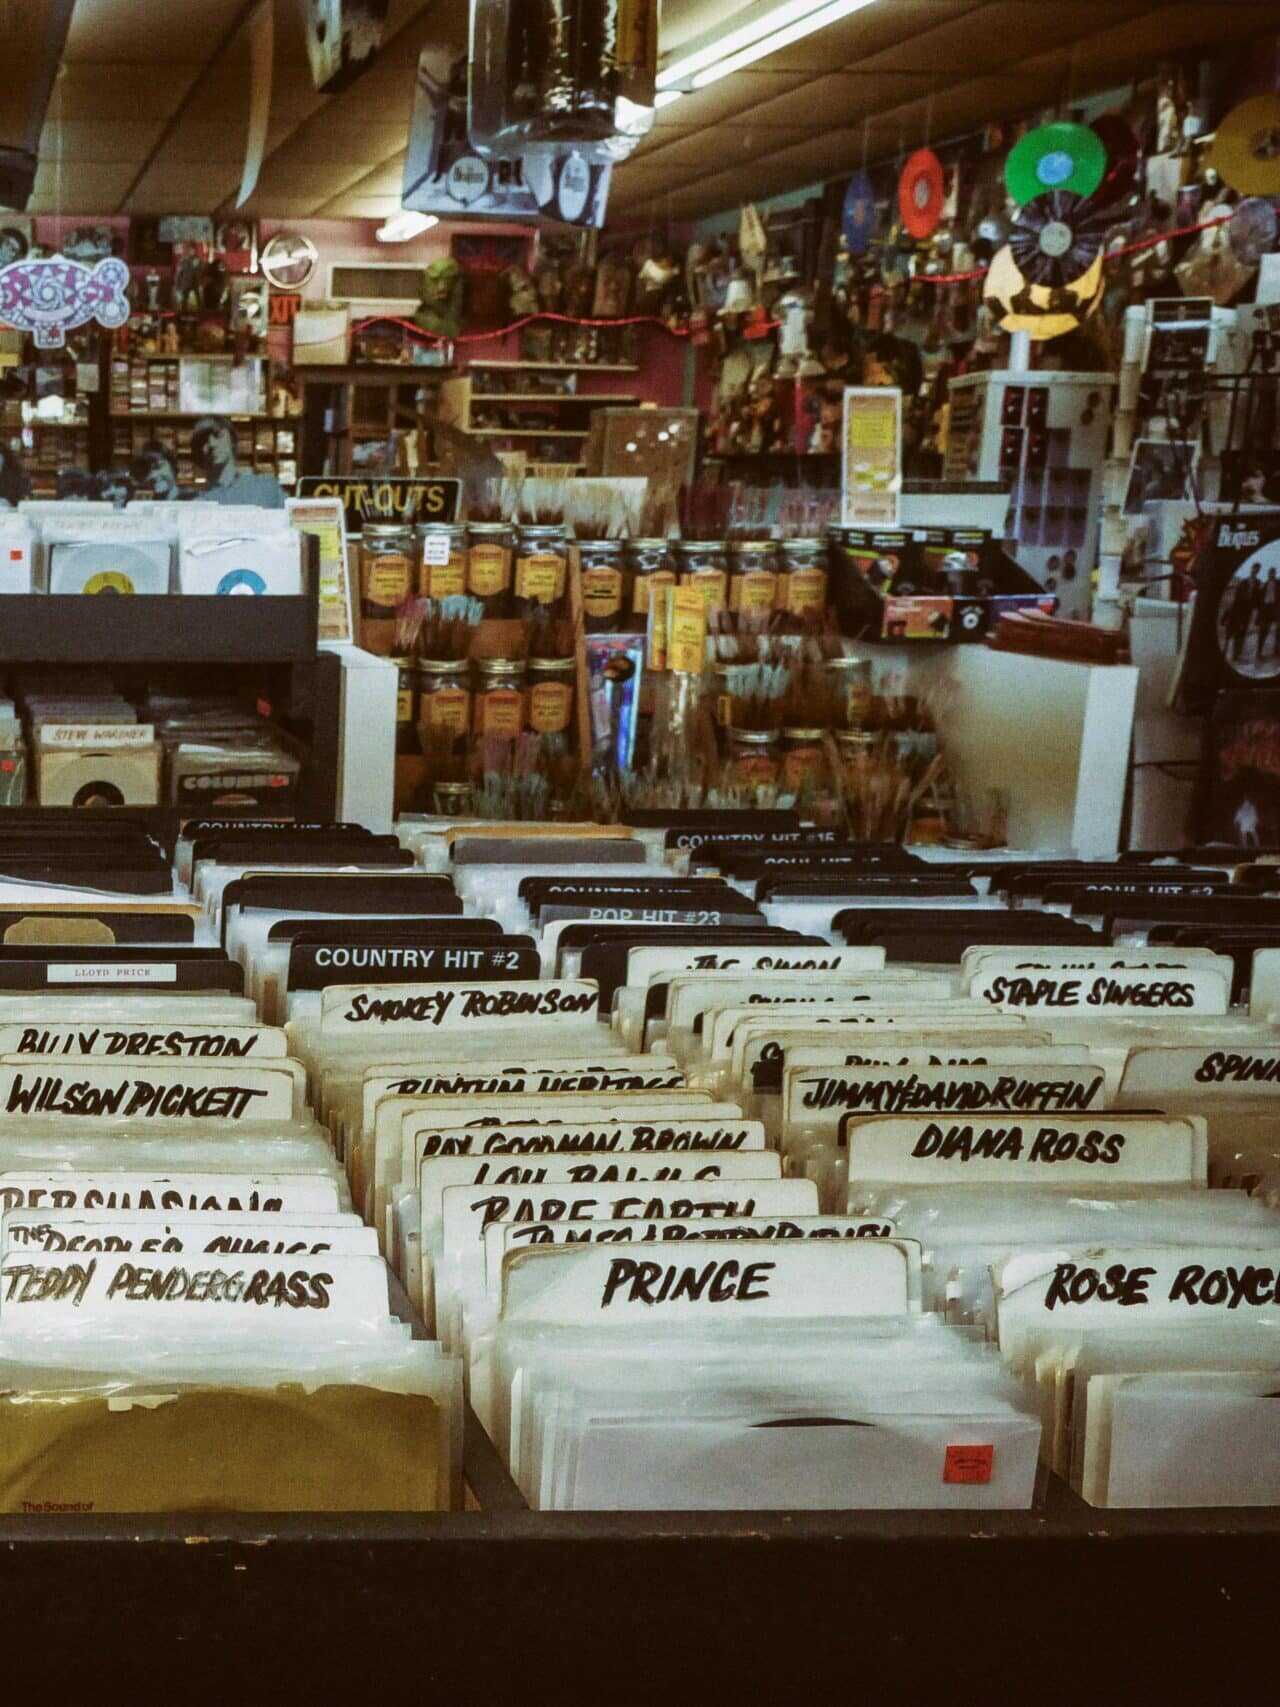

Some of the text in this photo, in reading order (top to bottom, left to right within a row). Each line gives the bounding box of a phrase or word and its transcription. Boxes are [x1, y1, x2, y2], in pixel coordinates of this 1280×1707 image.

[74, 967, 152, 977] LLOYD PRICE
[315, 948, 520, 970] COUNTRY HIT #2
[344, 988, 600, 1026] SMOKEY ROBINSON
[983, 976, 1196, 1008] STAPLE SINGERS
[5, 1073, 269, 1119] WILSON PICKETT
[910, 1124, 1126, 1165] DIANA ROSS
[1, 1257, 336, 1310] TEDDY PENDERGRASS
[600, 1257, 777, 1309] PRINCE
[1044, 1263, 1158, 1311] ROSE
[22, 1502, 95, 1513] The Sound of
